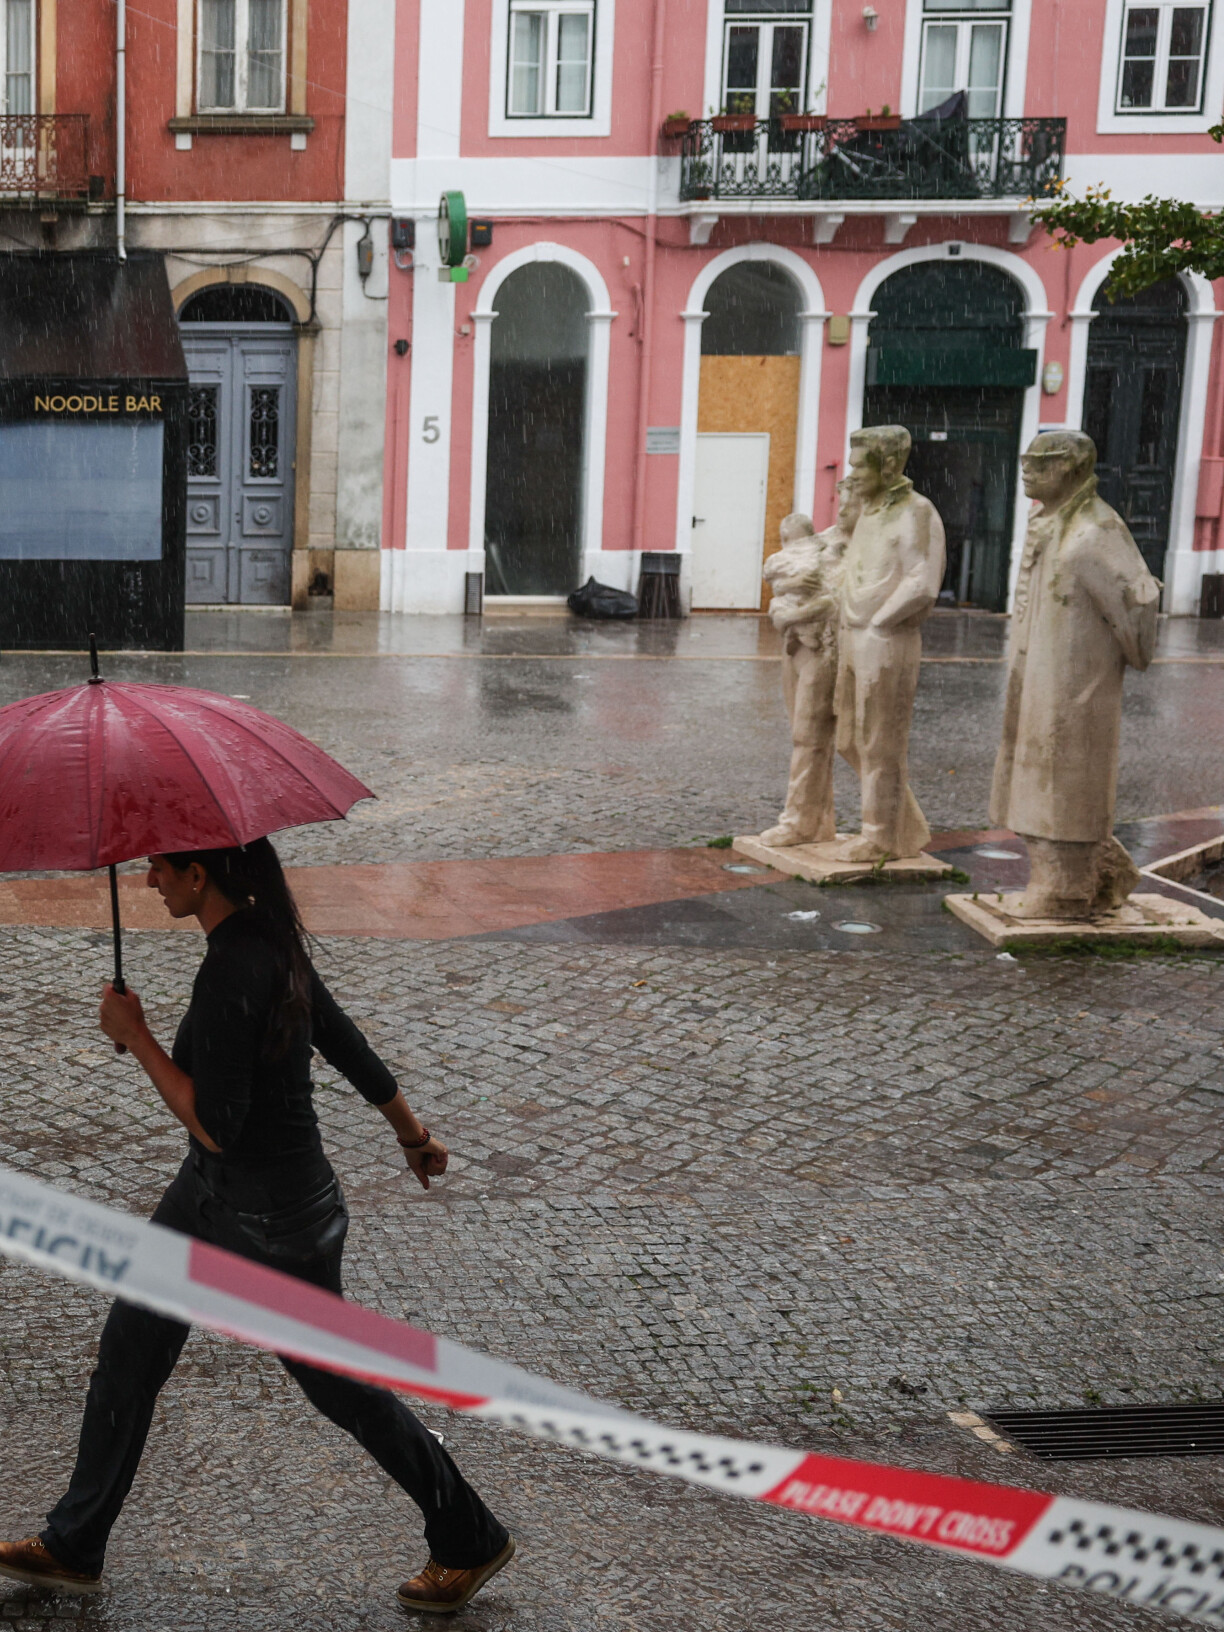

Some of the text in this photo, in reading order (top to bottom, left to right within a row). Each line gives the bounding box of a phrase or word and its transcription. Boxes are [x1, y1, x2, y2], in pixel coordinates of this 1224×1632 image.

[34, 395, 163, 412] NOODLE BAR
[422, 416, 440, 443] 5
[780, 1480, 1017, 1551] PLEASE DON'T CROSS
